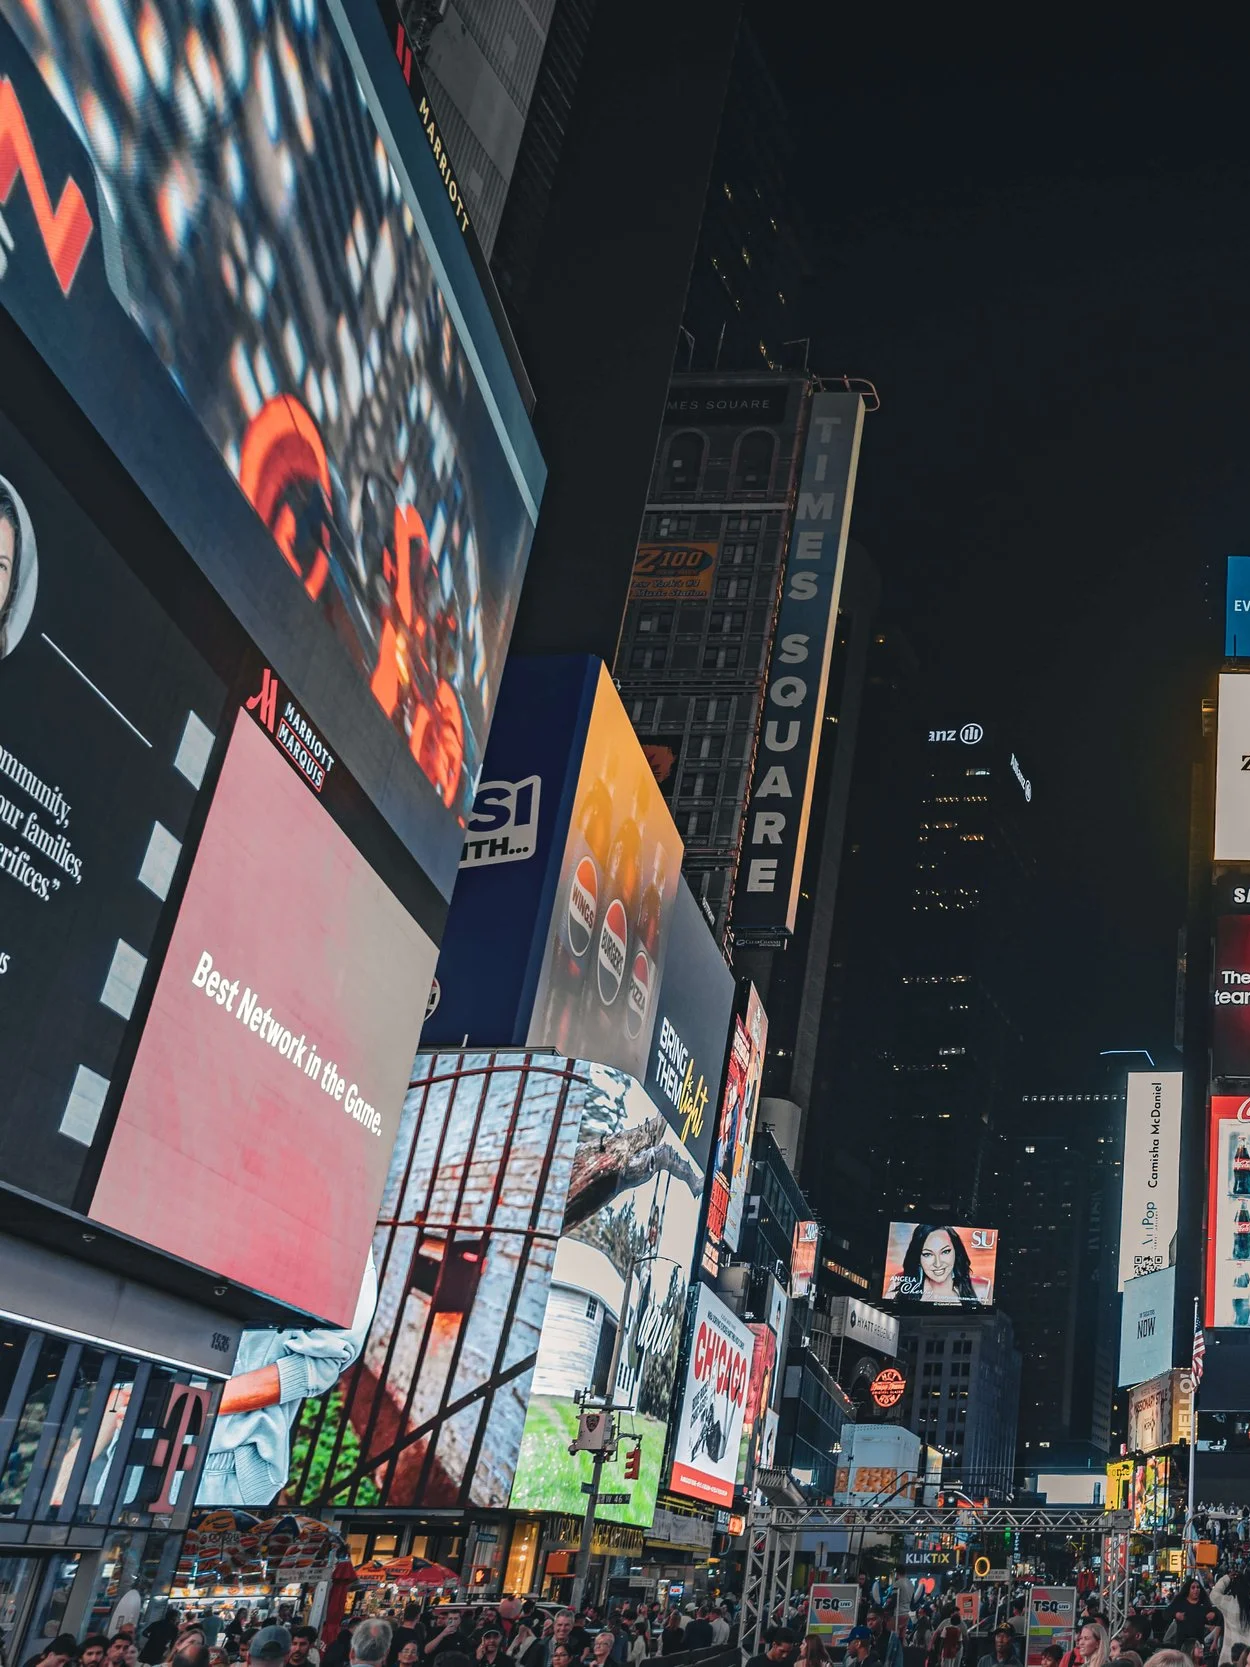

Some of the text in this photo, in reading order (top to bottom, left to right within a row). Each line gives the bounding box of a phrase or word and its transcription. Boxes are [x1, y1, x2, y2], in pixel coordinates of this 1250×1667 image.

[420, 97, 469, 232] MARRIOTT
[788, 416, 842, 601] TIMES
[278, 723, 323, 786] MARQUIS
[285, 702, 334, 771] MARRIOTT
[746, 633, 808, 893] SQUARE
[22, 812, 83, 884] families,
[572, 883, 594, 929] WINGS
[601, 927, 624, 977] BURGERS
[630, 980, 646, 1014] PIZZA
[192, 950, 382, 1136] Best Network in the Game.
[659, 1017, 688, 1076] BRING
[656, 1050, 682, 1110] THEM
[1151, 1082, 1162, 1135] McDaniel
[1148, 1139, 1160, 1188] Camisha
[971, 1231, 995, 1247] SU
[857, 1316, 874, 1332] HYATT
[1137, 1316, 1156, 1340] NOW
[694, 1321, 747, 1409] CHICAGO
[905, 1553, 950, 1564] KLIKTIX
[814, 1598, 839, 1611] TSQ
[1034, 1600, 1058, 1613] TSQ
